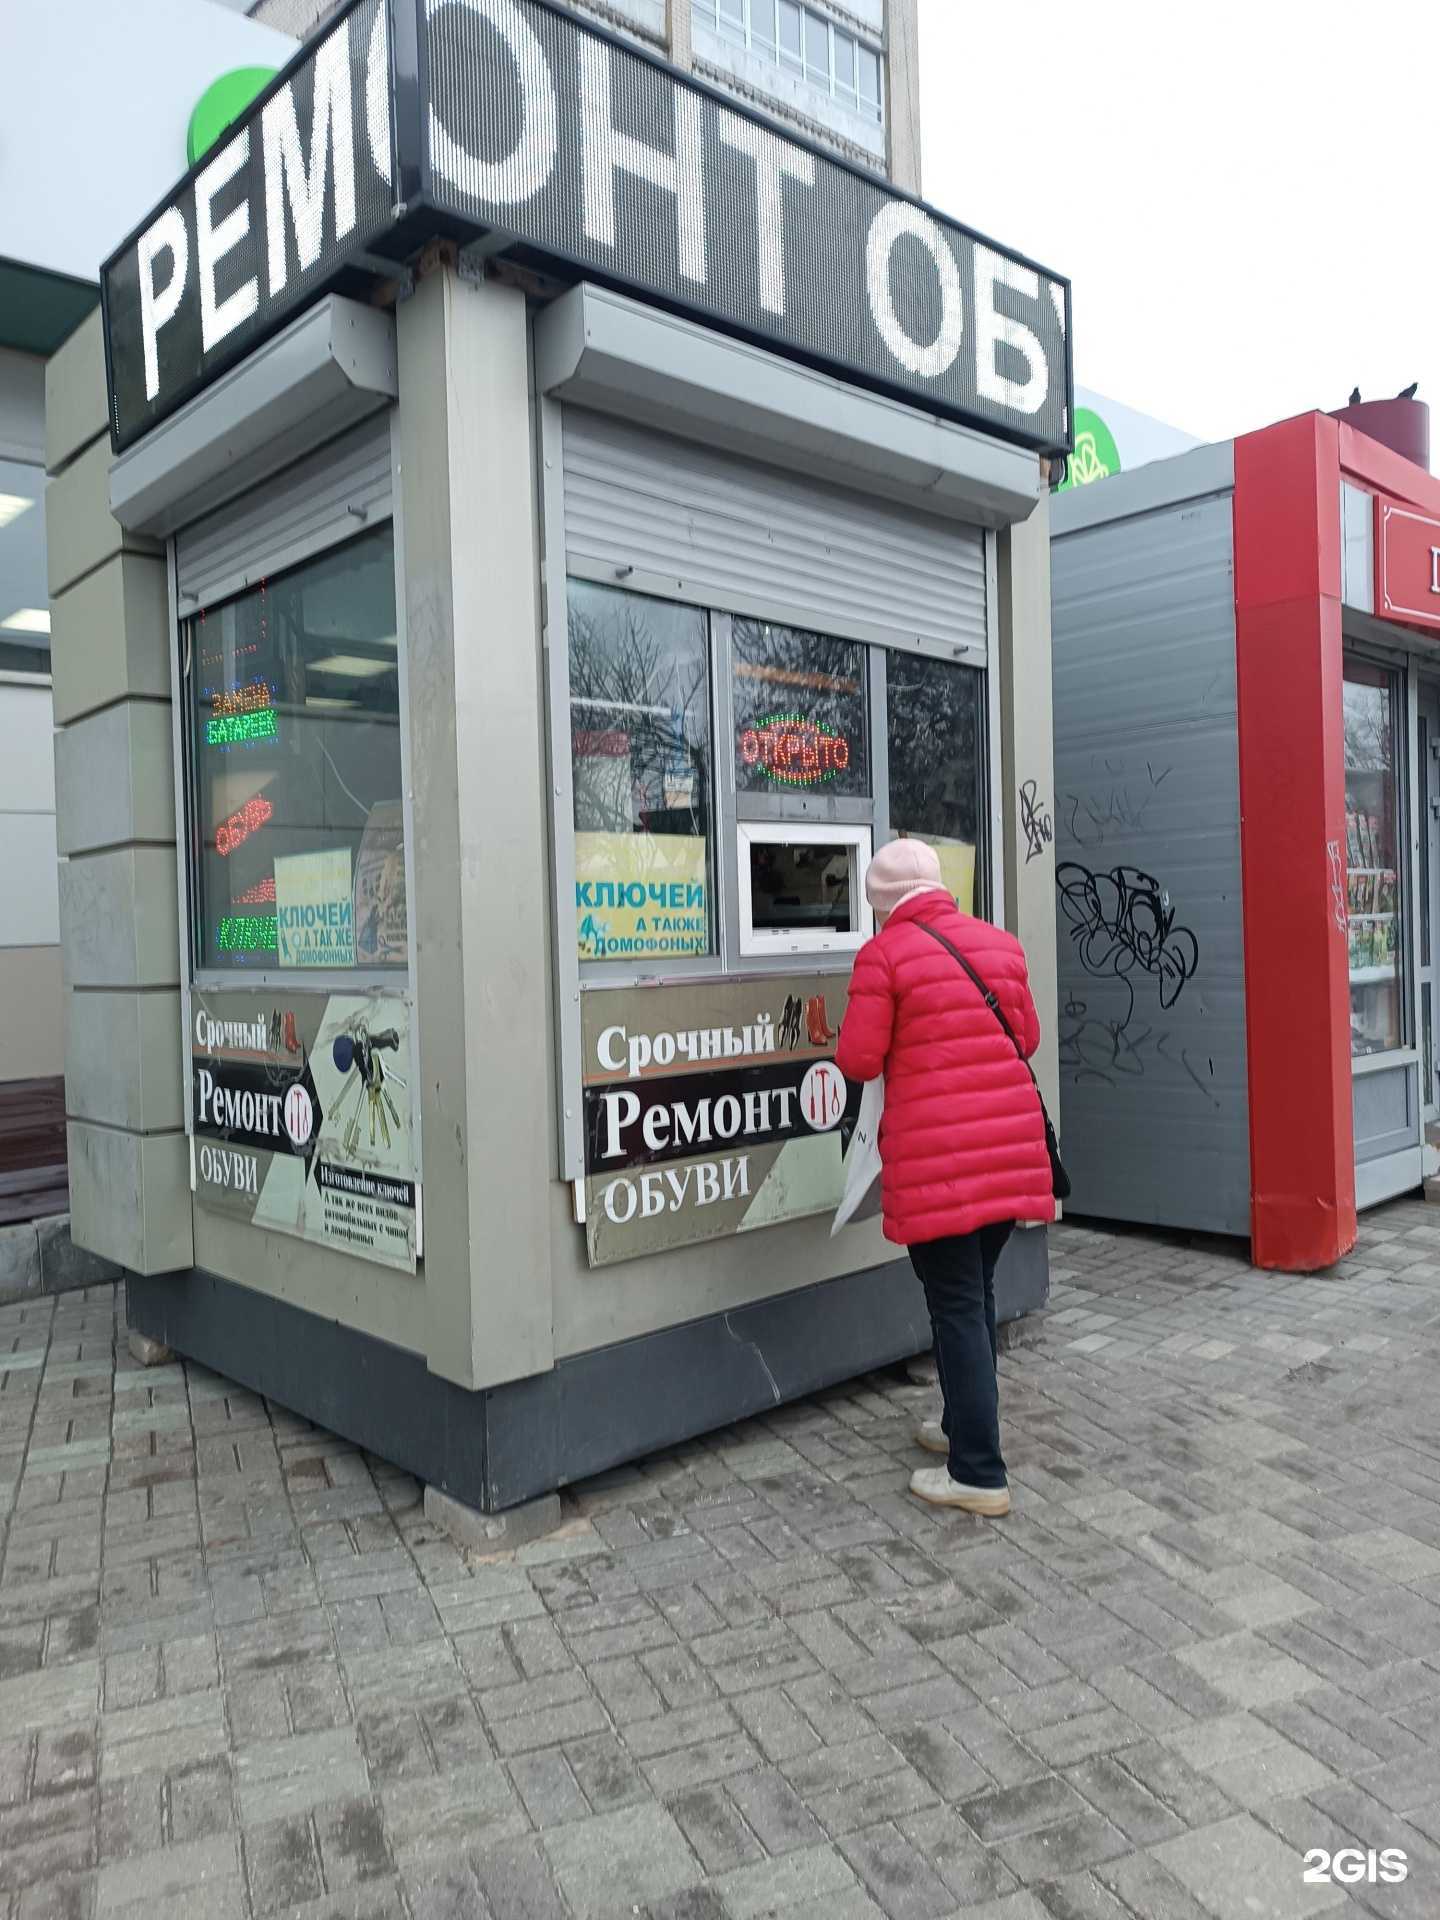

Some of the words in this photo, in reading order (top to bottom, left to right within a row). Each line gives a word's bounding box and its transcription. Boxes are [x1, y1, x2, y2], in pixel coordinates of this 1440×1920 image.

[208, 709, 277, 745] БАТАРЕЕК
[743, 730, 849, 769] ОТКРЫТО
[279, 897, 352, 928] КЛЮЧЕЙ
[576, 878, 703, 909] КЛЮЧЕЙ
[304, 930, 311, 947] А
[636, 917, 647, 932] А
[196, 1010, 267, 1055] Срочный
[597, 1012, 776, 1078] Срочный
[198, 1069, 283, 1137] Ремонт
[600, 1086, 798, 1159] Ремонт
[201, 1145, 259, 1195] ОБУВИ
[320, 1165, 375, 1194] Изготовление
[377, 1181, 409, 1203] ключей
[604, 1155, 752, 1224] ОБУВИ
[358, 1202, 373, 1214] всех
[376, 1206, 399, 1221] видов
